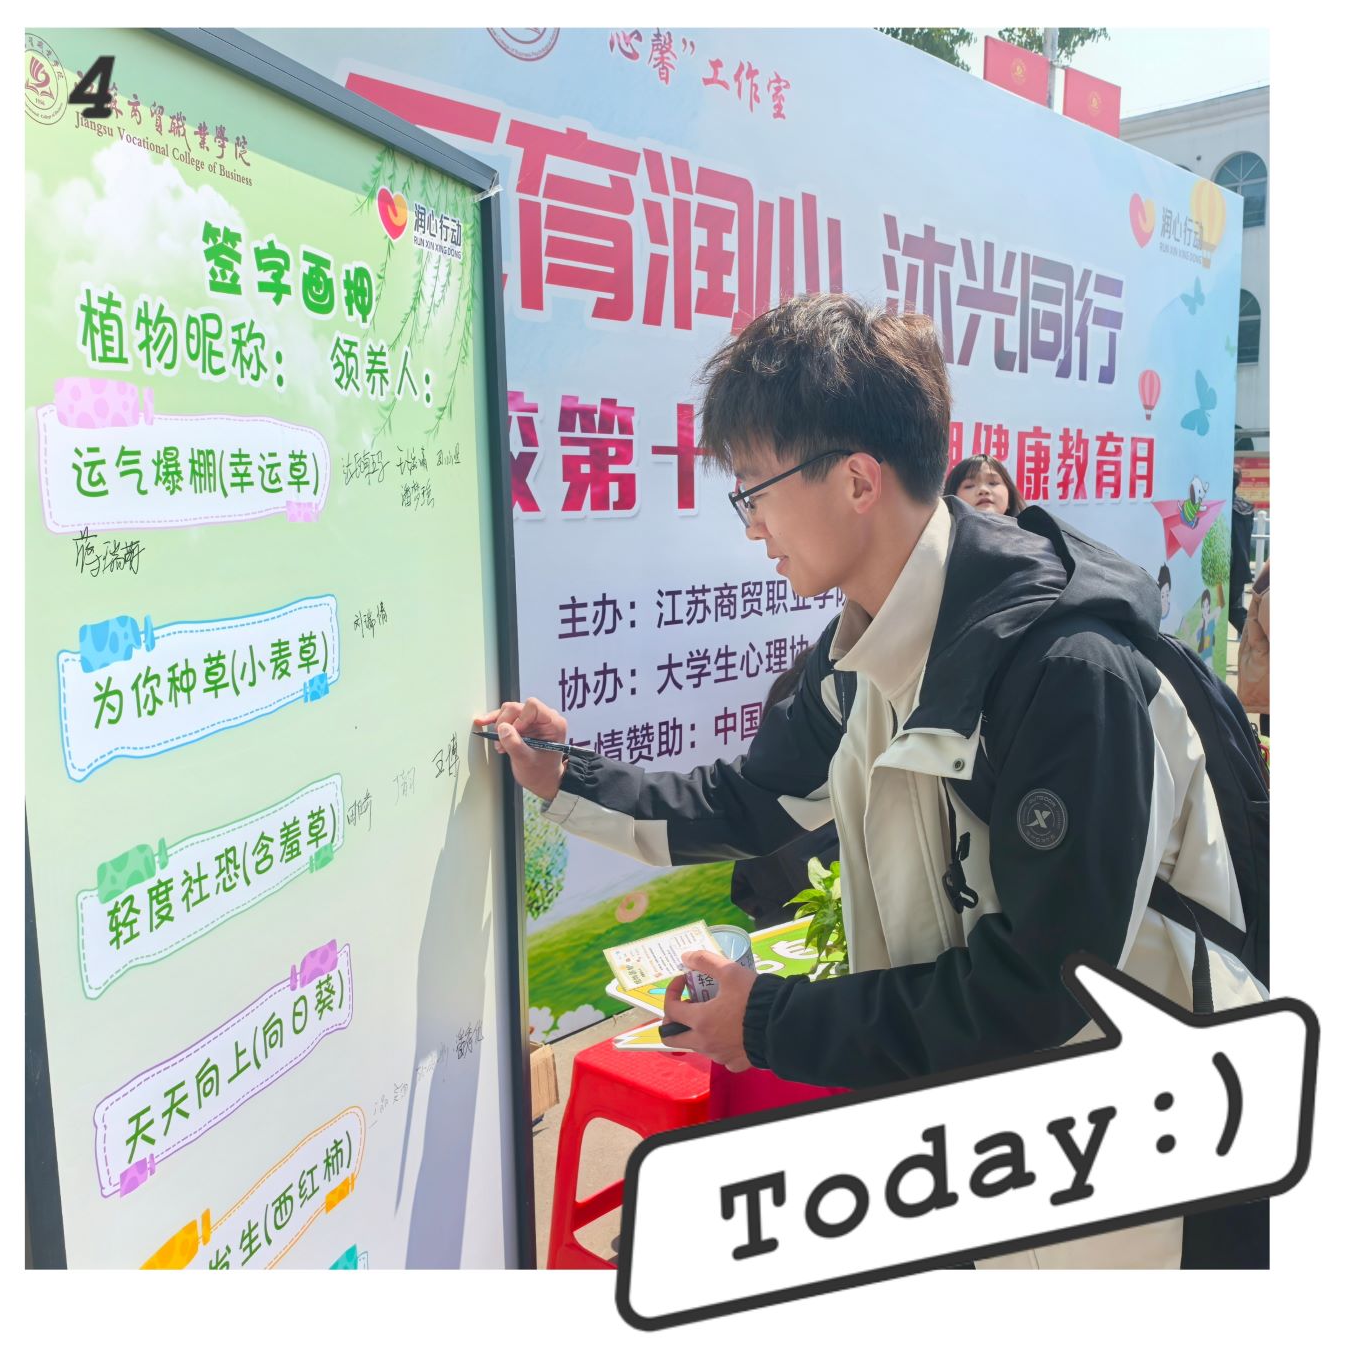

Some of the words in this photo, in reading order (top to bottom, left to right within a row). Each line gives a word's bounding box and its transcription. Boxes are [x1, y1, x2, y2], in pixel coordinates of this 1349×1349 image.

[75, 111, 114, 137] Jiangsu
[117, 127, 169, 158] Vocational
[172, 148, 205, 171] College
[208, 162, 216, 173] of
[219, 164, 253, 186] Business
[202, 221, 374, 325] 签字画押
[414, 203, 462, 247] 润心行动
[1161, 207, 1204, 251] 润心行动
[883, 212, 1125, 385] 沐光同行
[71, 445, 320, 498] 运气爆棚(幸运草)
[93, 631, 329, 729] 为你种草(小麦草)
[106, 803, 337, 951] 轻度社恐(含羞草)
[125, 969, 346, 1164] 天天向上(向日葵)
